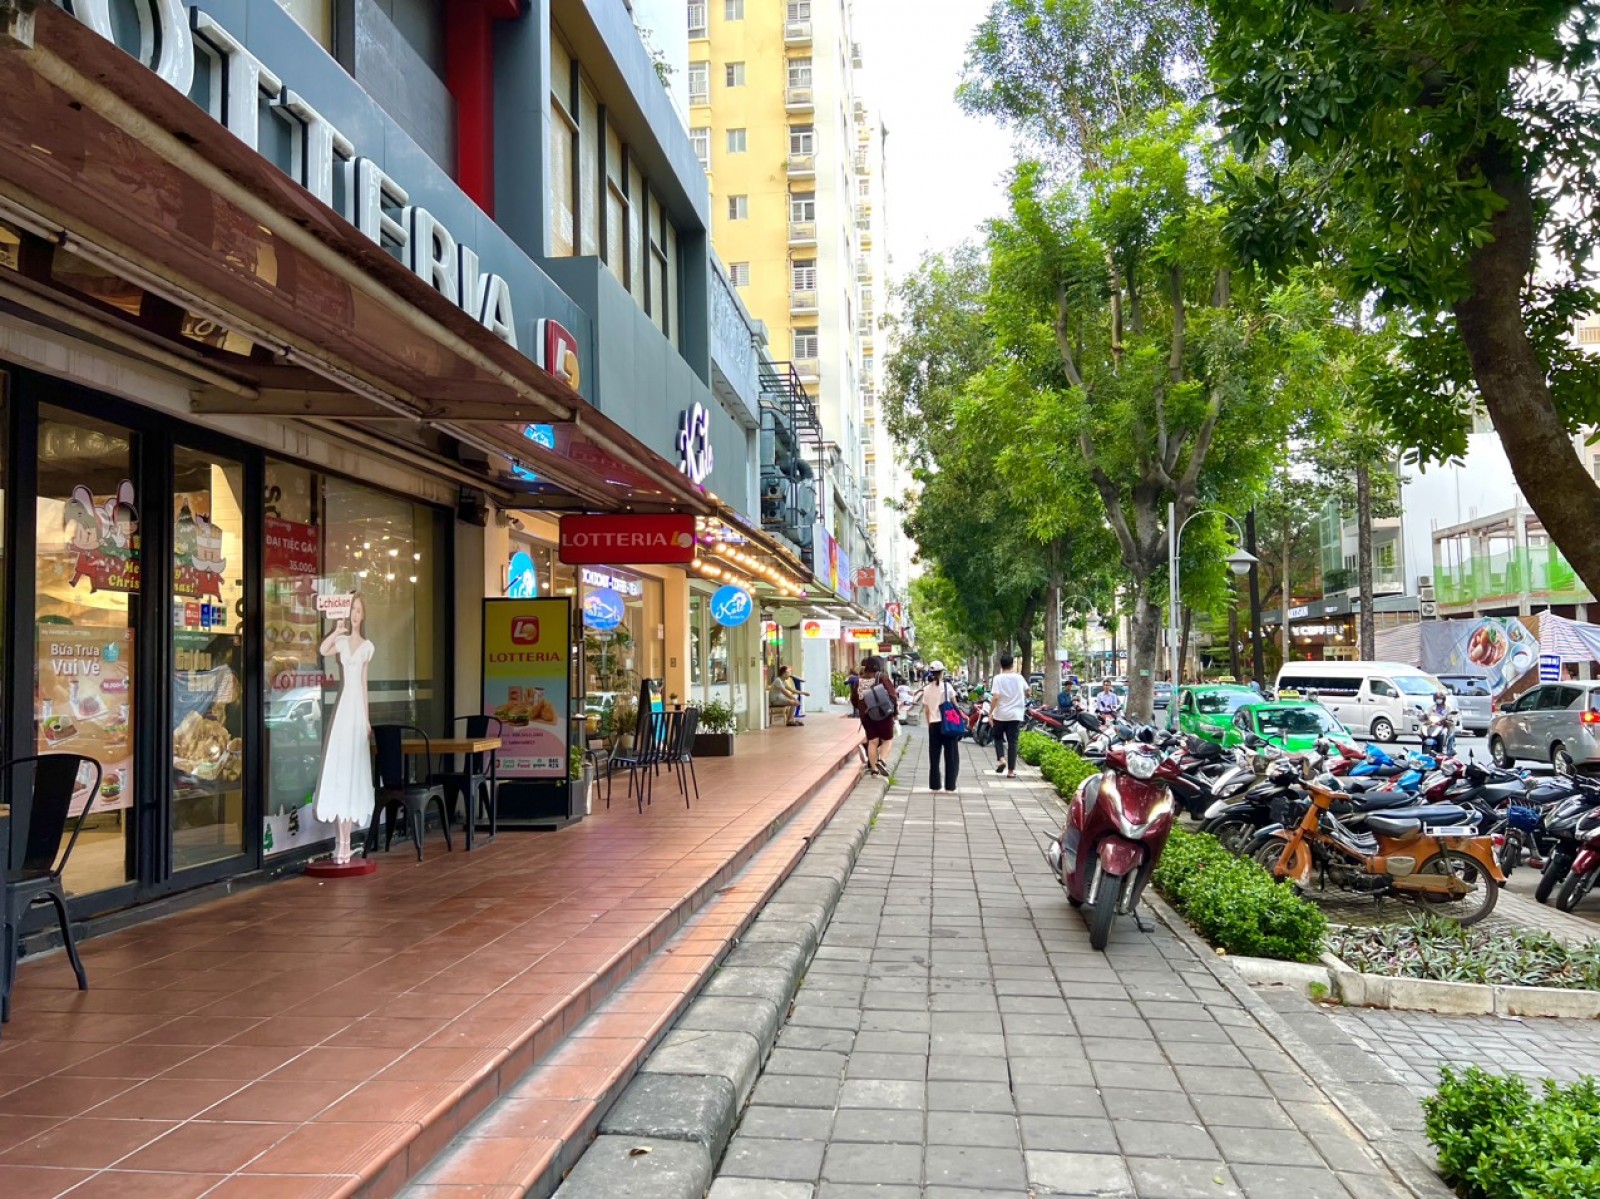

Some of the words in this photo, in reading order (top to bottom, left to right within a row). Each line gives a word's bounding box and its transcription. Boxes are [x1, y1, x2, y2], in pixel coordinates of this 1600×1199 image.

[562, 532, 667, 547] LOTTERIA
[75, 644, 100, 656] Trưa
[489, 652, 561, 663] LOTTERIA
[51, 657, 77, 675] Vui
